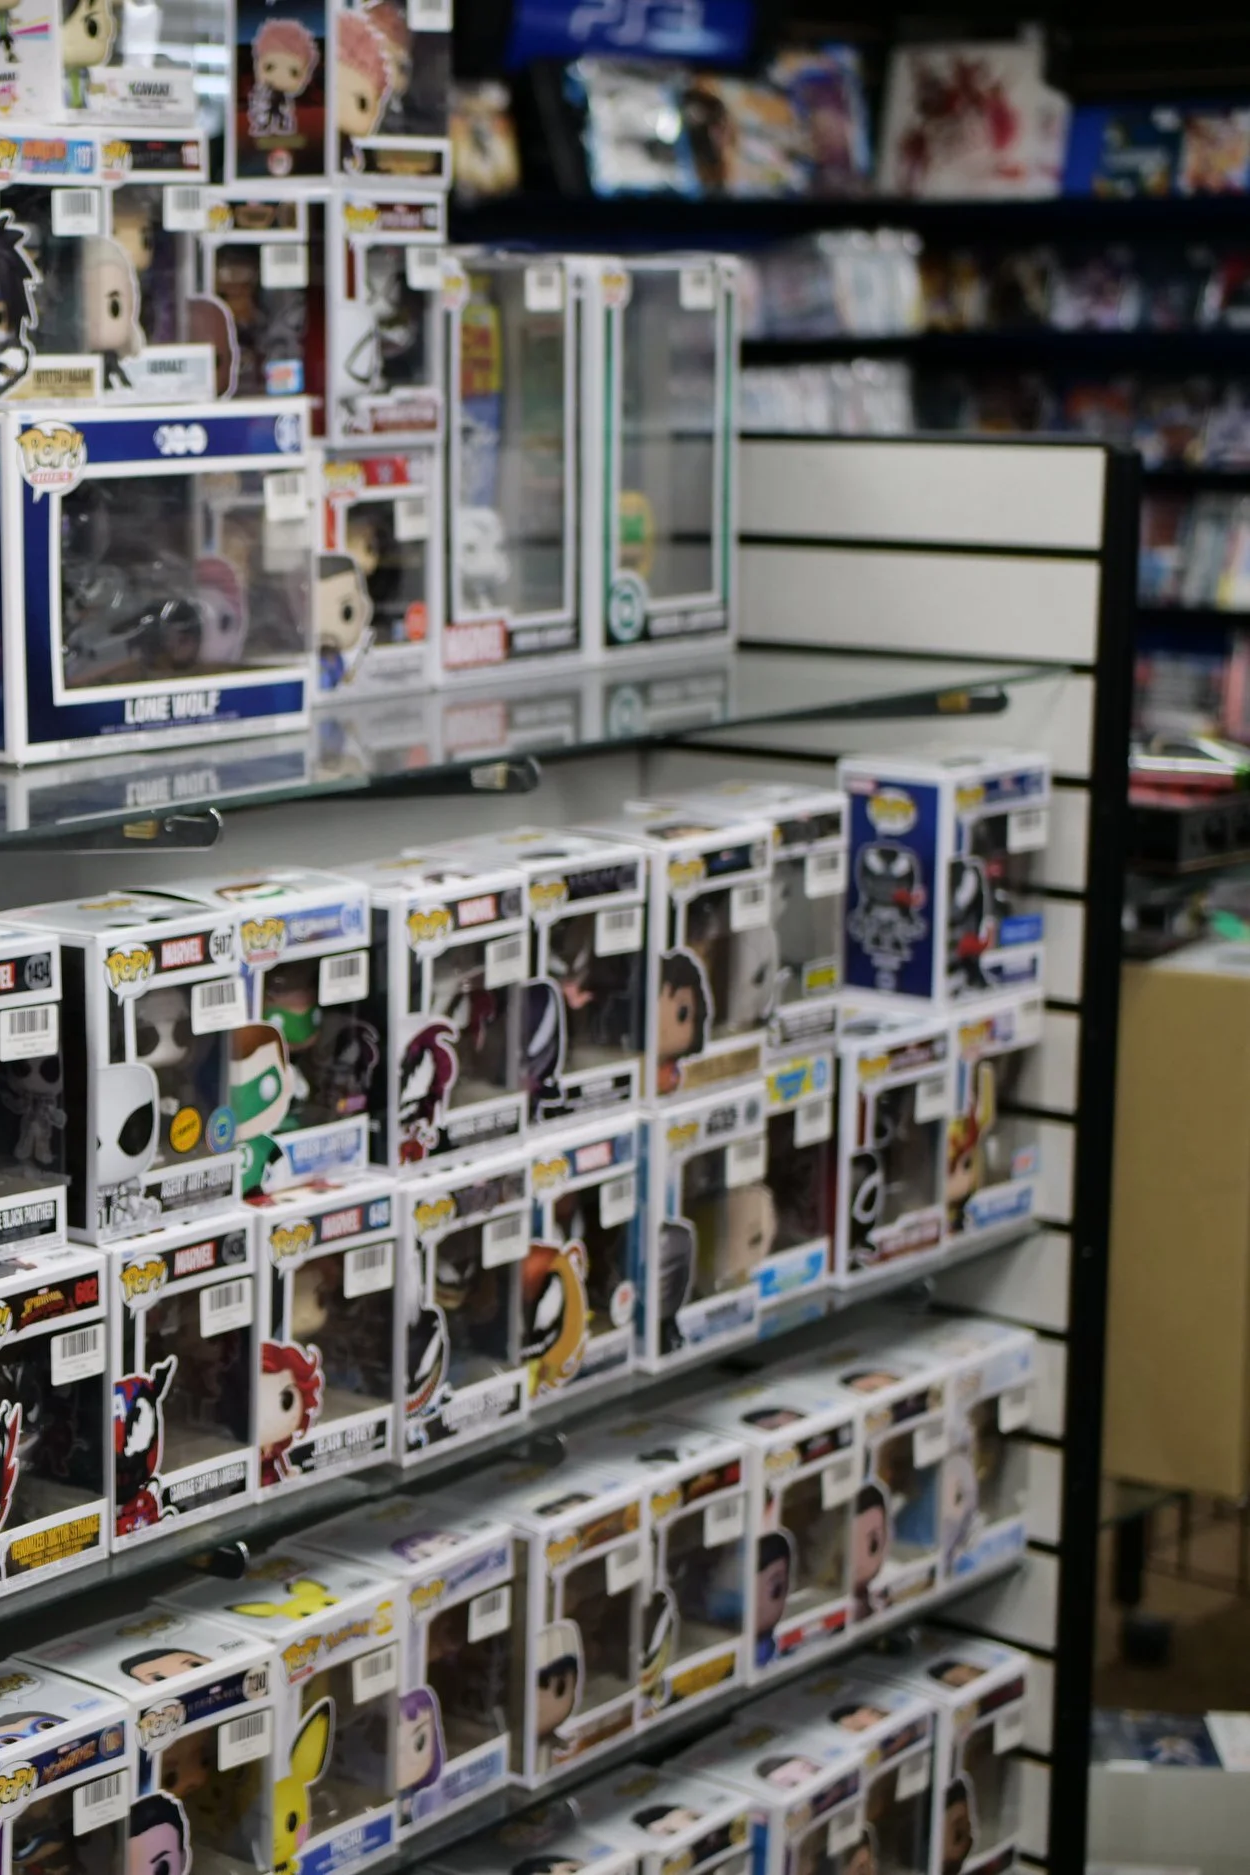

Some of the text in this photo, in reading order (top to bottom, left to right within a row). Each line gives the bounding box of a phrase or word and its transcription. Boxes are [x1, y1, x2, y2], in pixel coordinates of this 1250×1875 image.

[125, 690, 220, 724] LONE WOLF
[161, 935, 204, 969] MARVEL
[104, 950, 153, 989] POP!
[2, 1207, 24, 1229] BLACK
[24, 1201, 56, 1224] PANTHER
[174, 1241, 217, 1277] MARVEL
